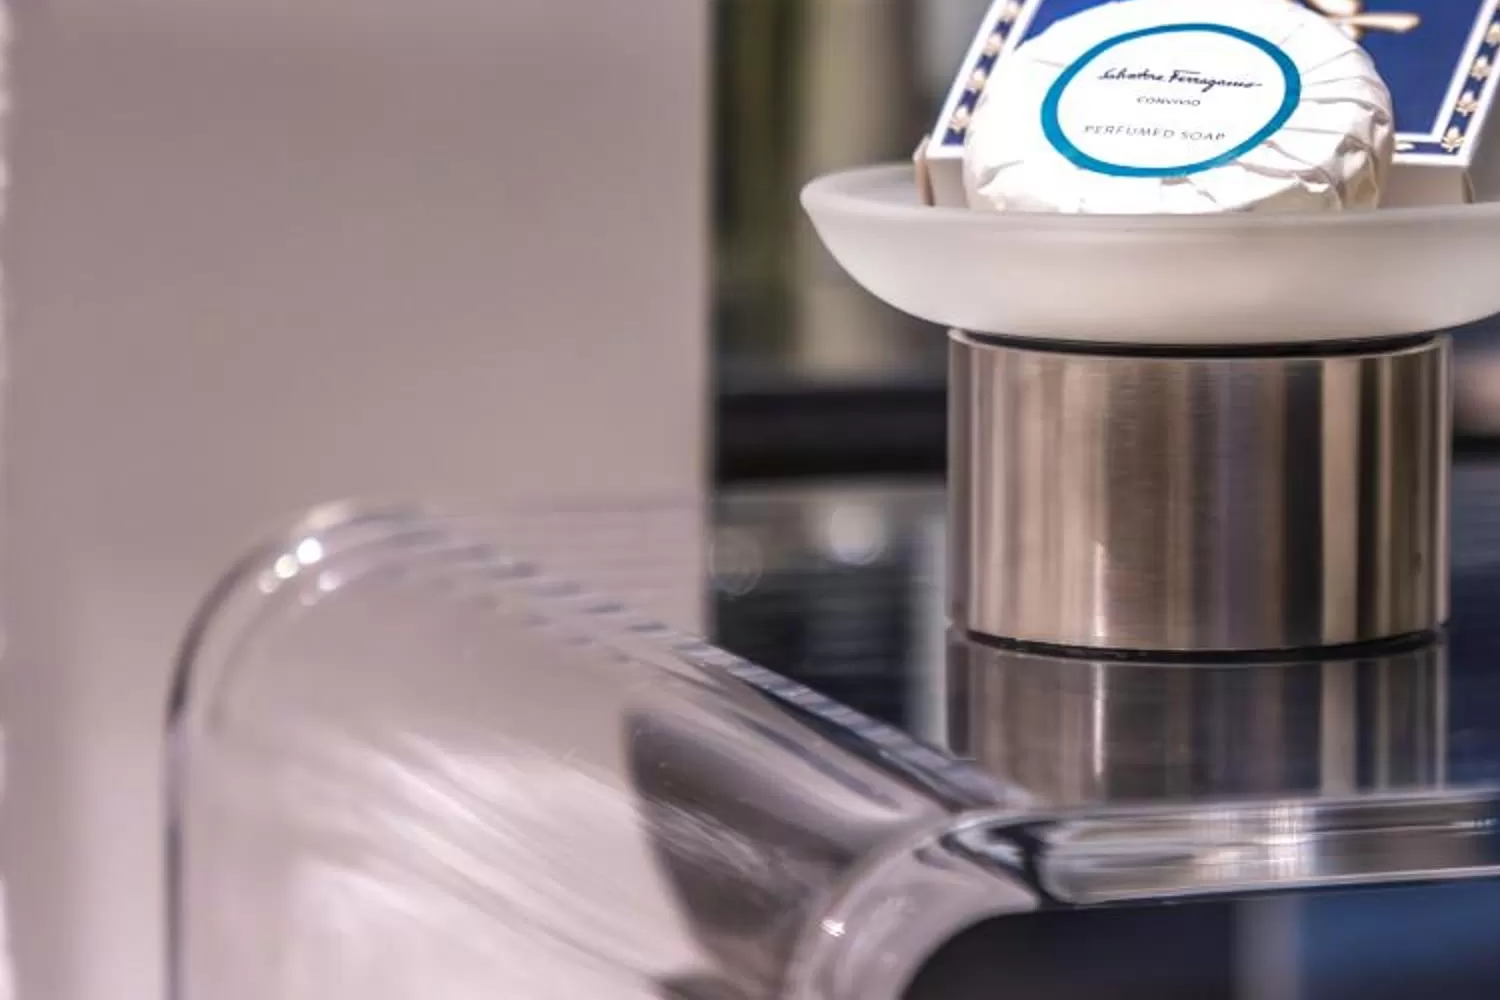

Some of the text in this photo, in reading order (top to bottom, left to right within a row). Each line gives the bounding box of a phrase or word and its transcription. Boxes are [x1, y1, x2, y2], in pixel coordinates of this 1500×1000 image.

[1167, 69, 1262, 93] Ferragamo
[1084, 125, 1226, 141] PERFUMED SOAP
